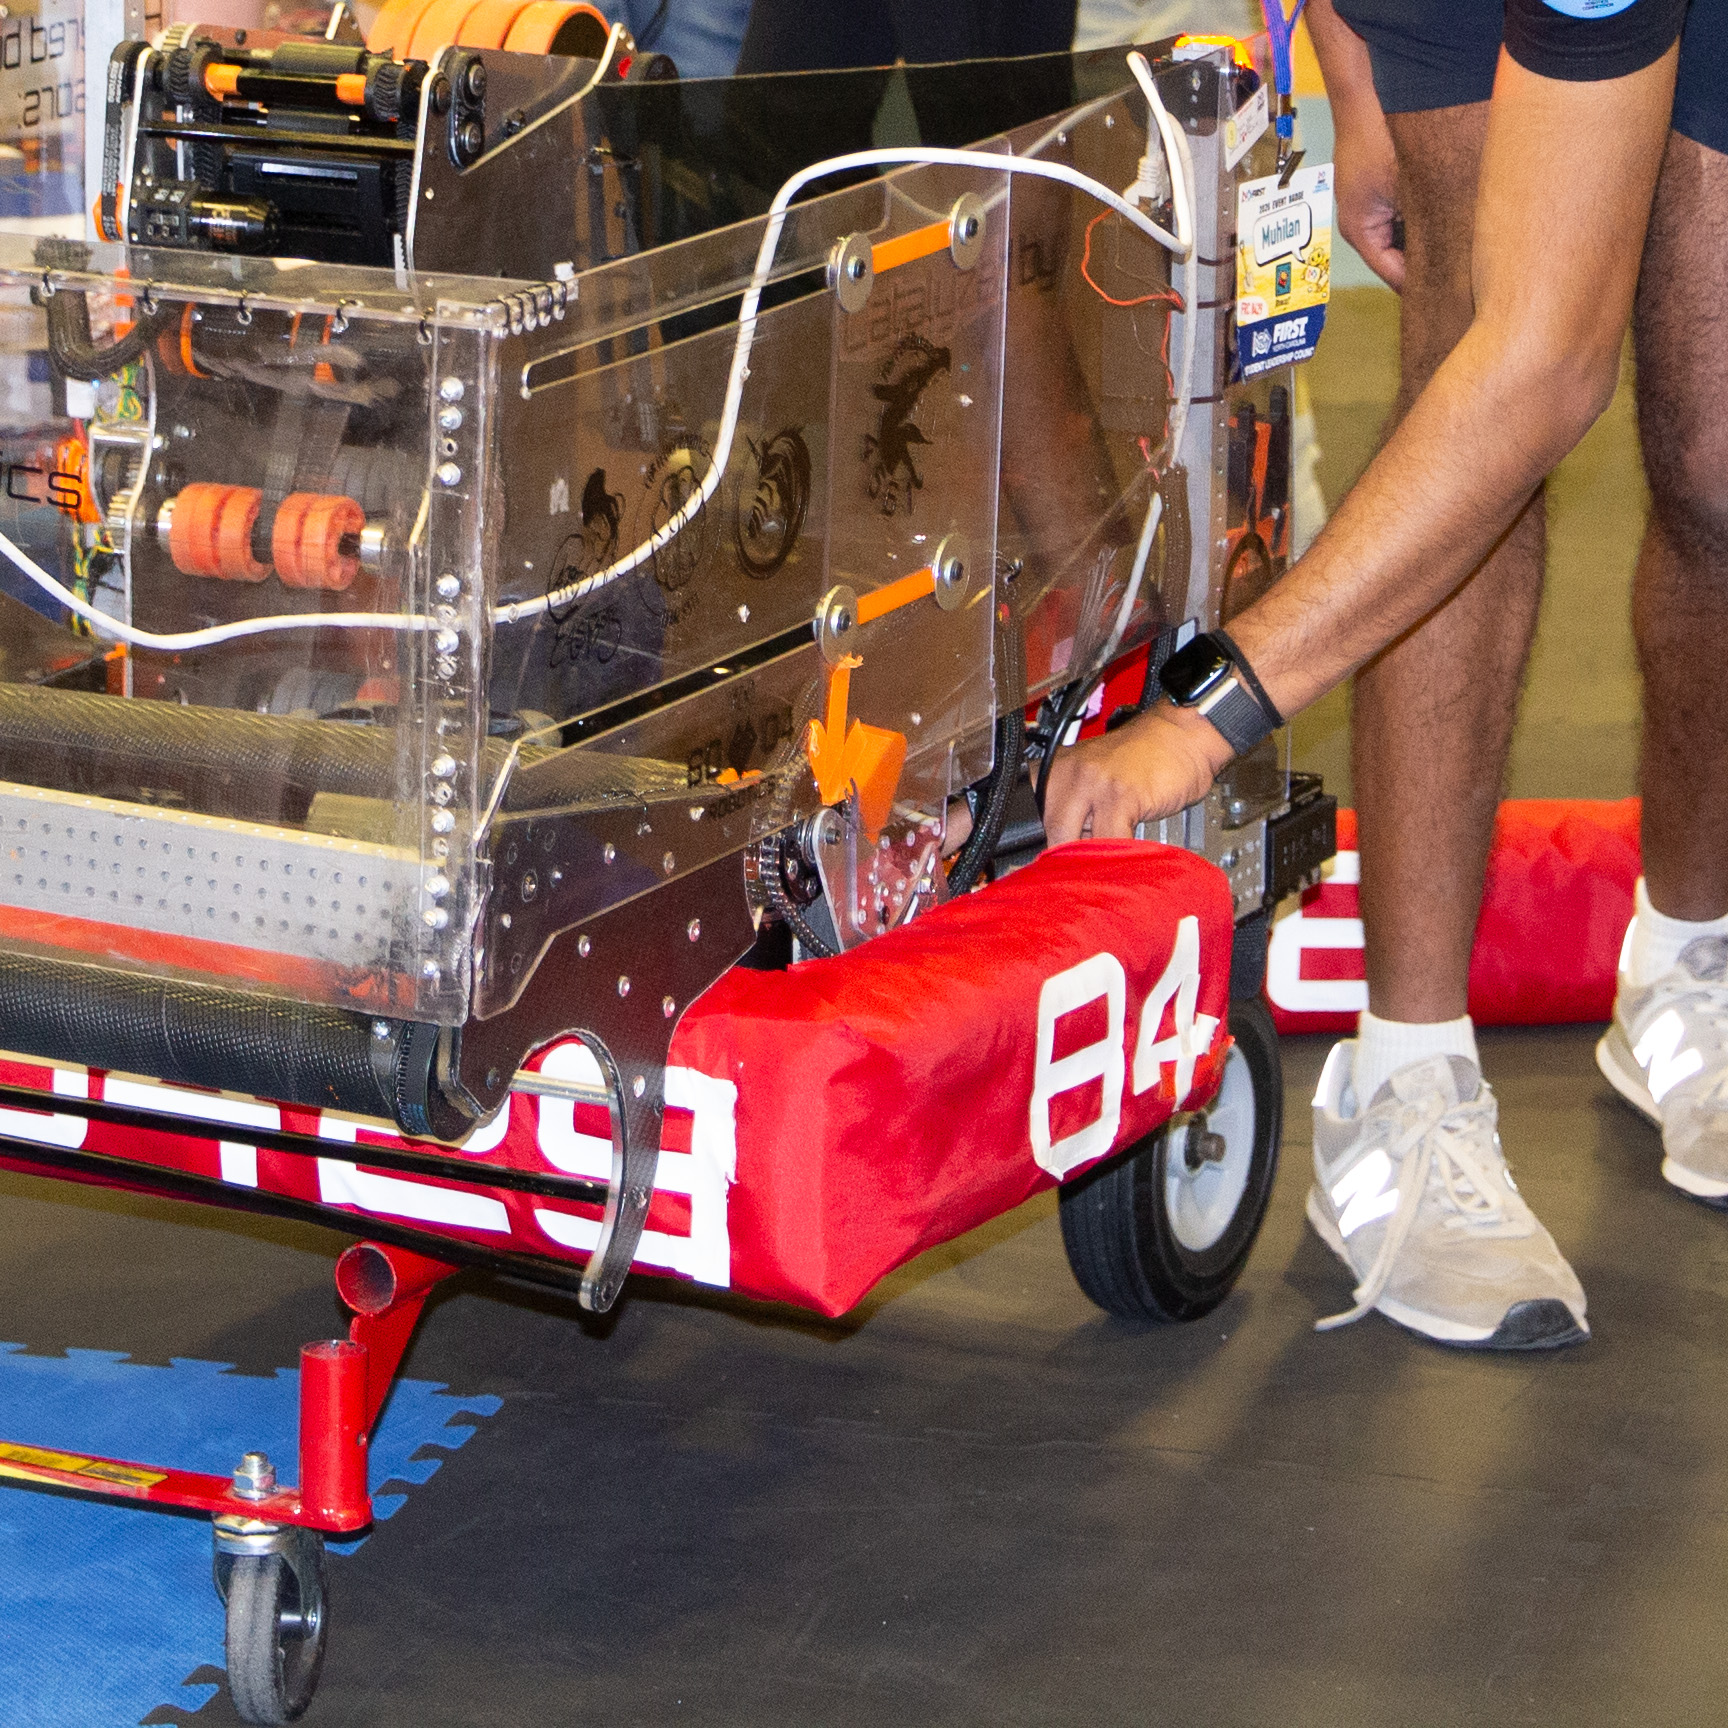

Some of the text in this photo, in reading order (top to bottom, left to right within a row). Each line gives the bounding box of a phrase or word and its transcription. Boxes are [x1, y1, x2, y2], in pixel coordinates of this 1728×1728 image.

[1272, 196, 1287, 209] EVENT
[1262, 218, 1301, 250] Muhilan
[1273, 316, 1309, 344] FIRST
[1030, 915, 1219, 1181] 84
